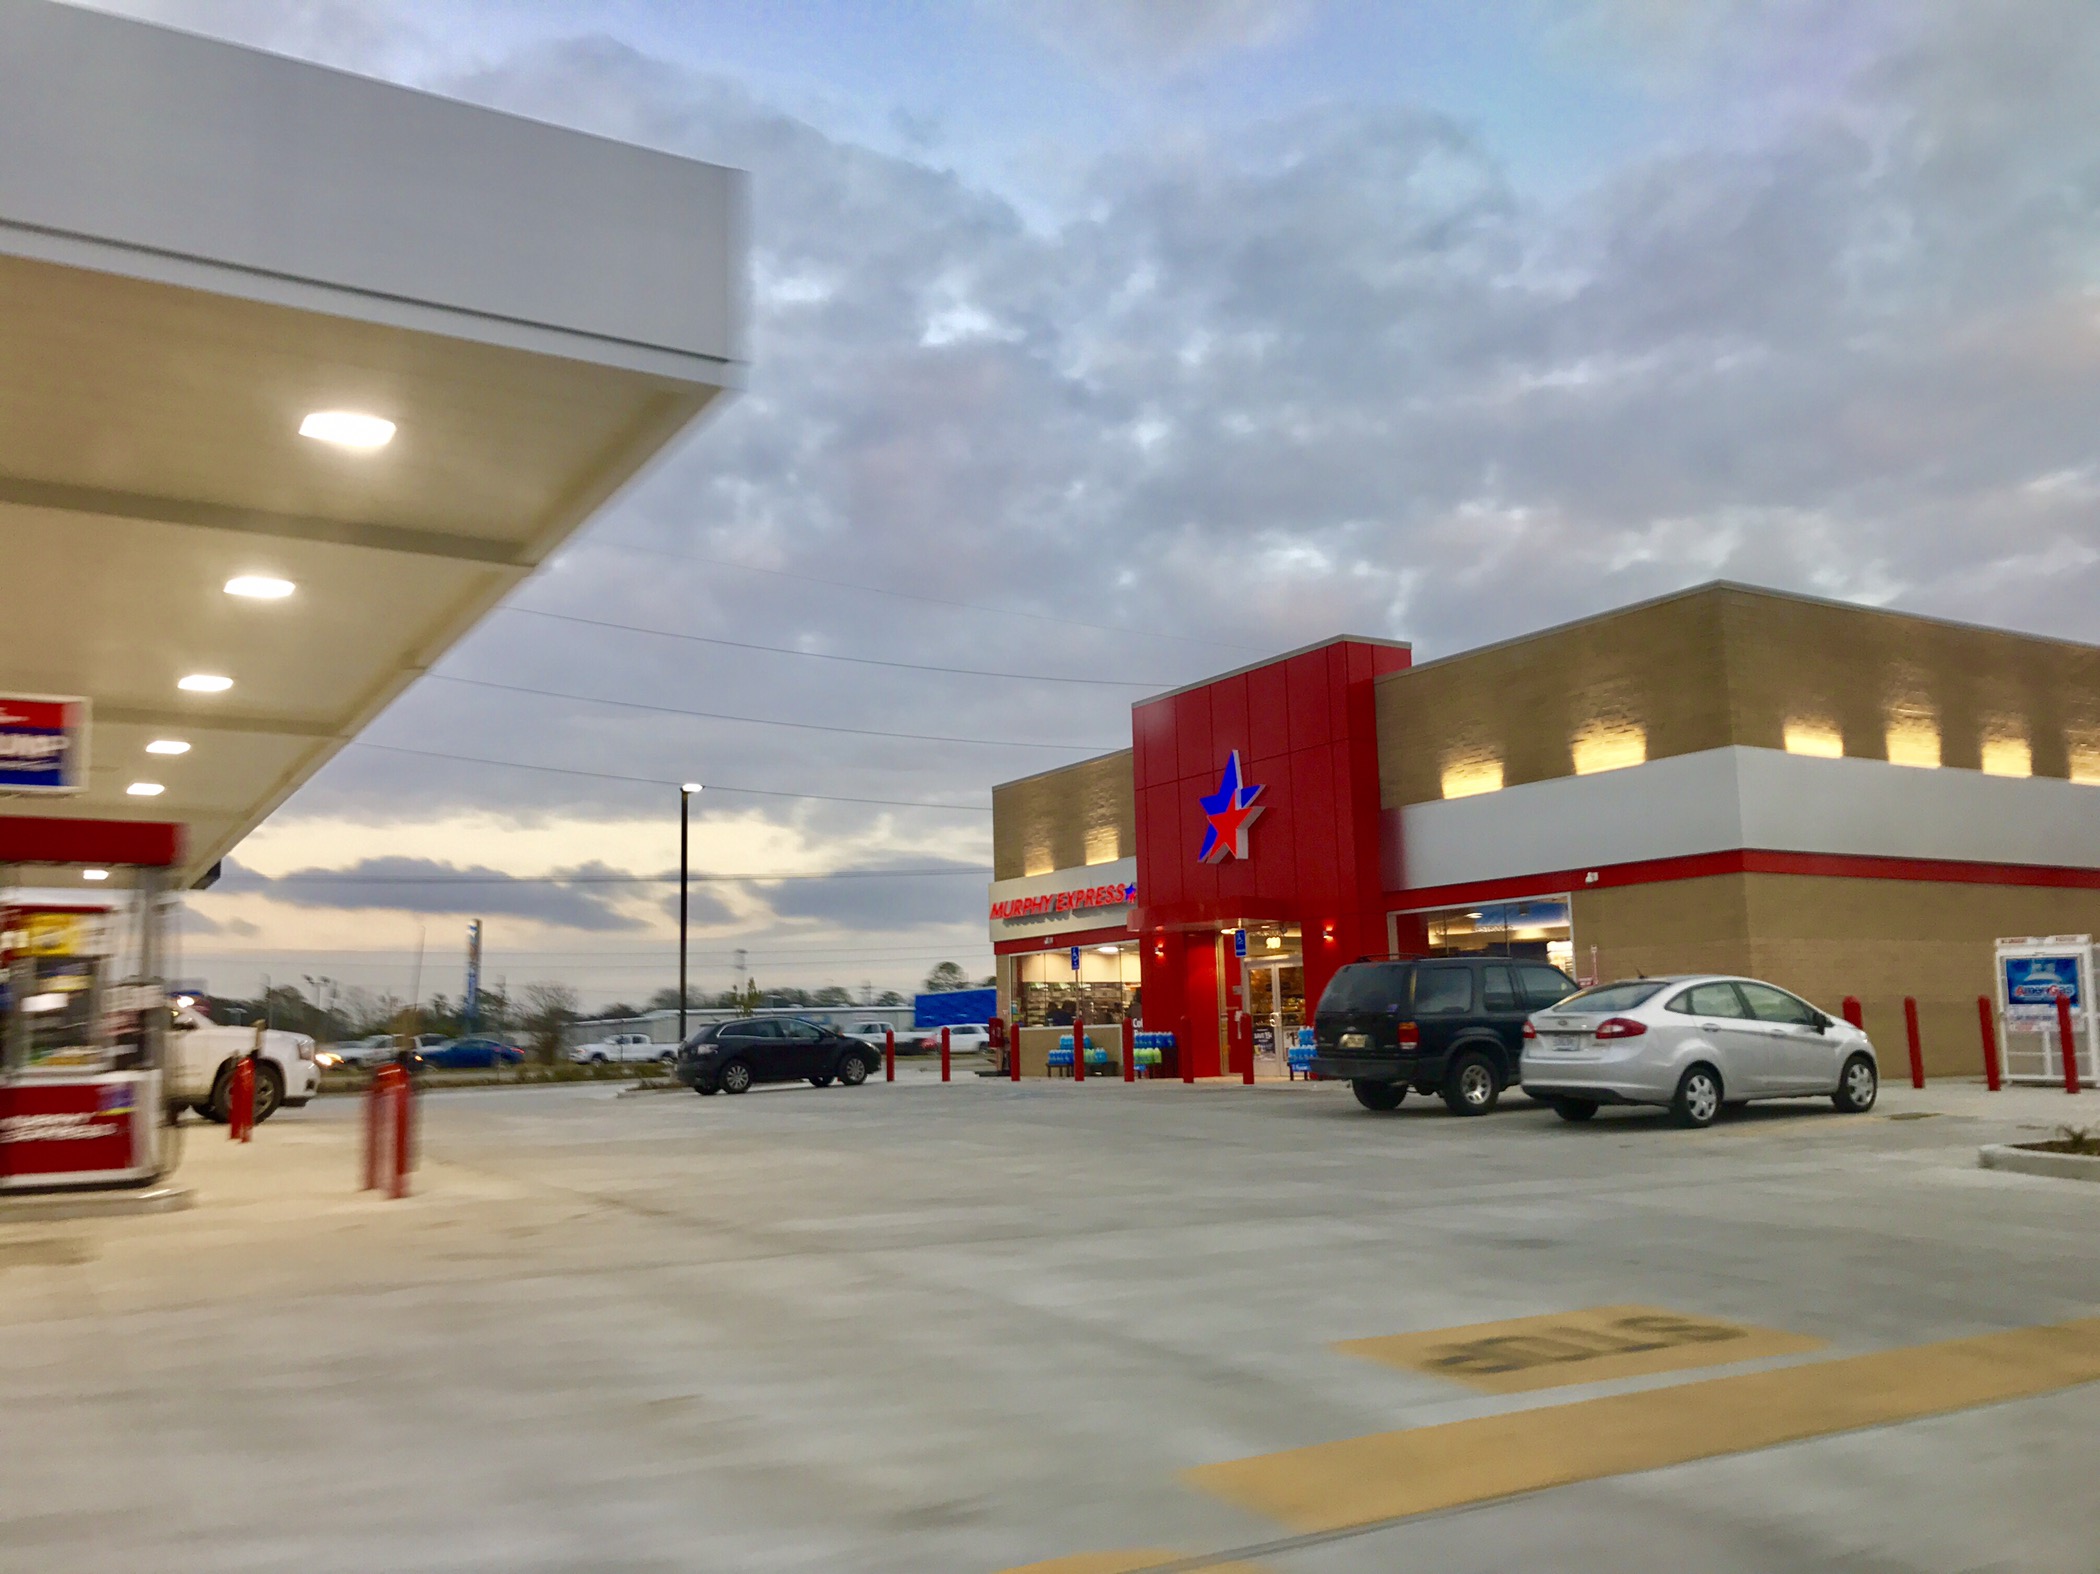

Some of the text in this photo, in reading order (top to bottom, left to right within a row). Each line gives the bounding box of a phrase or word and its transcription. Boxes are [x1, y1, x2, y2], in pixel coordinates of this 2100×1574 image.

[990, 883, 1126, 920] MURPHY EXPRESS
[1421, 1315, 1749, 1375] STOP
